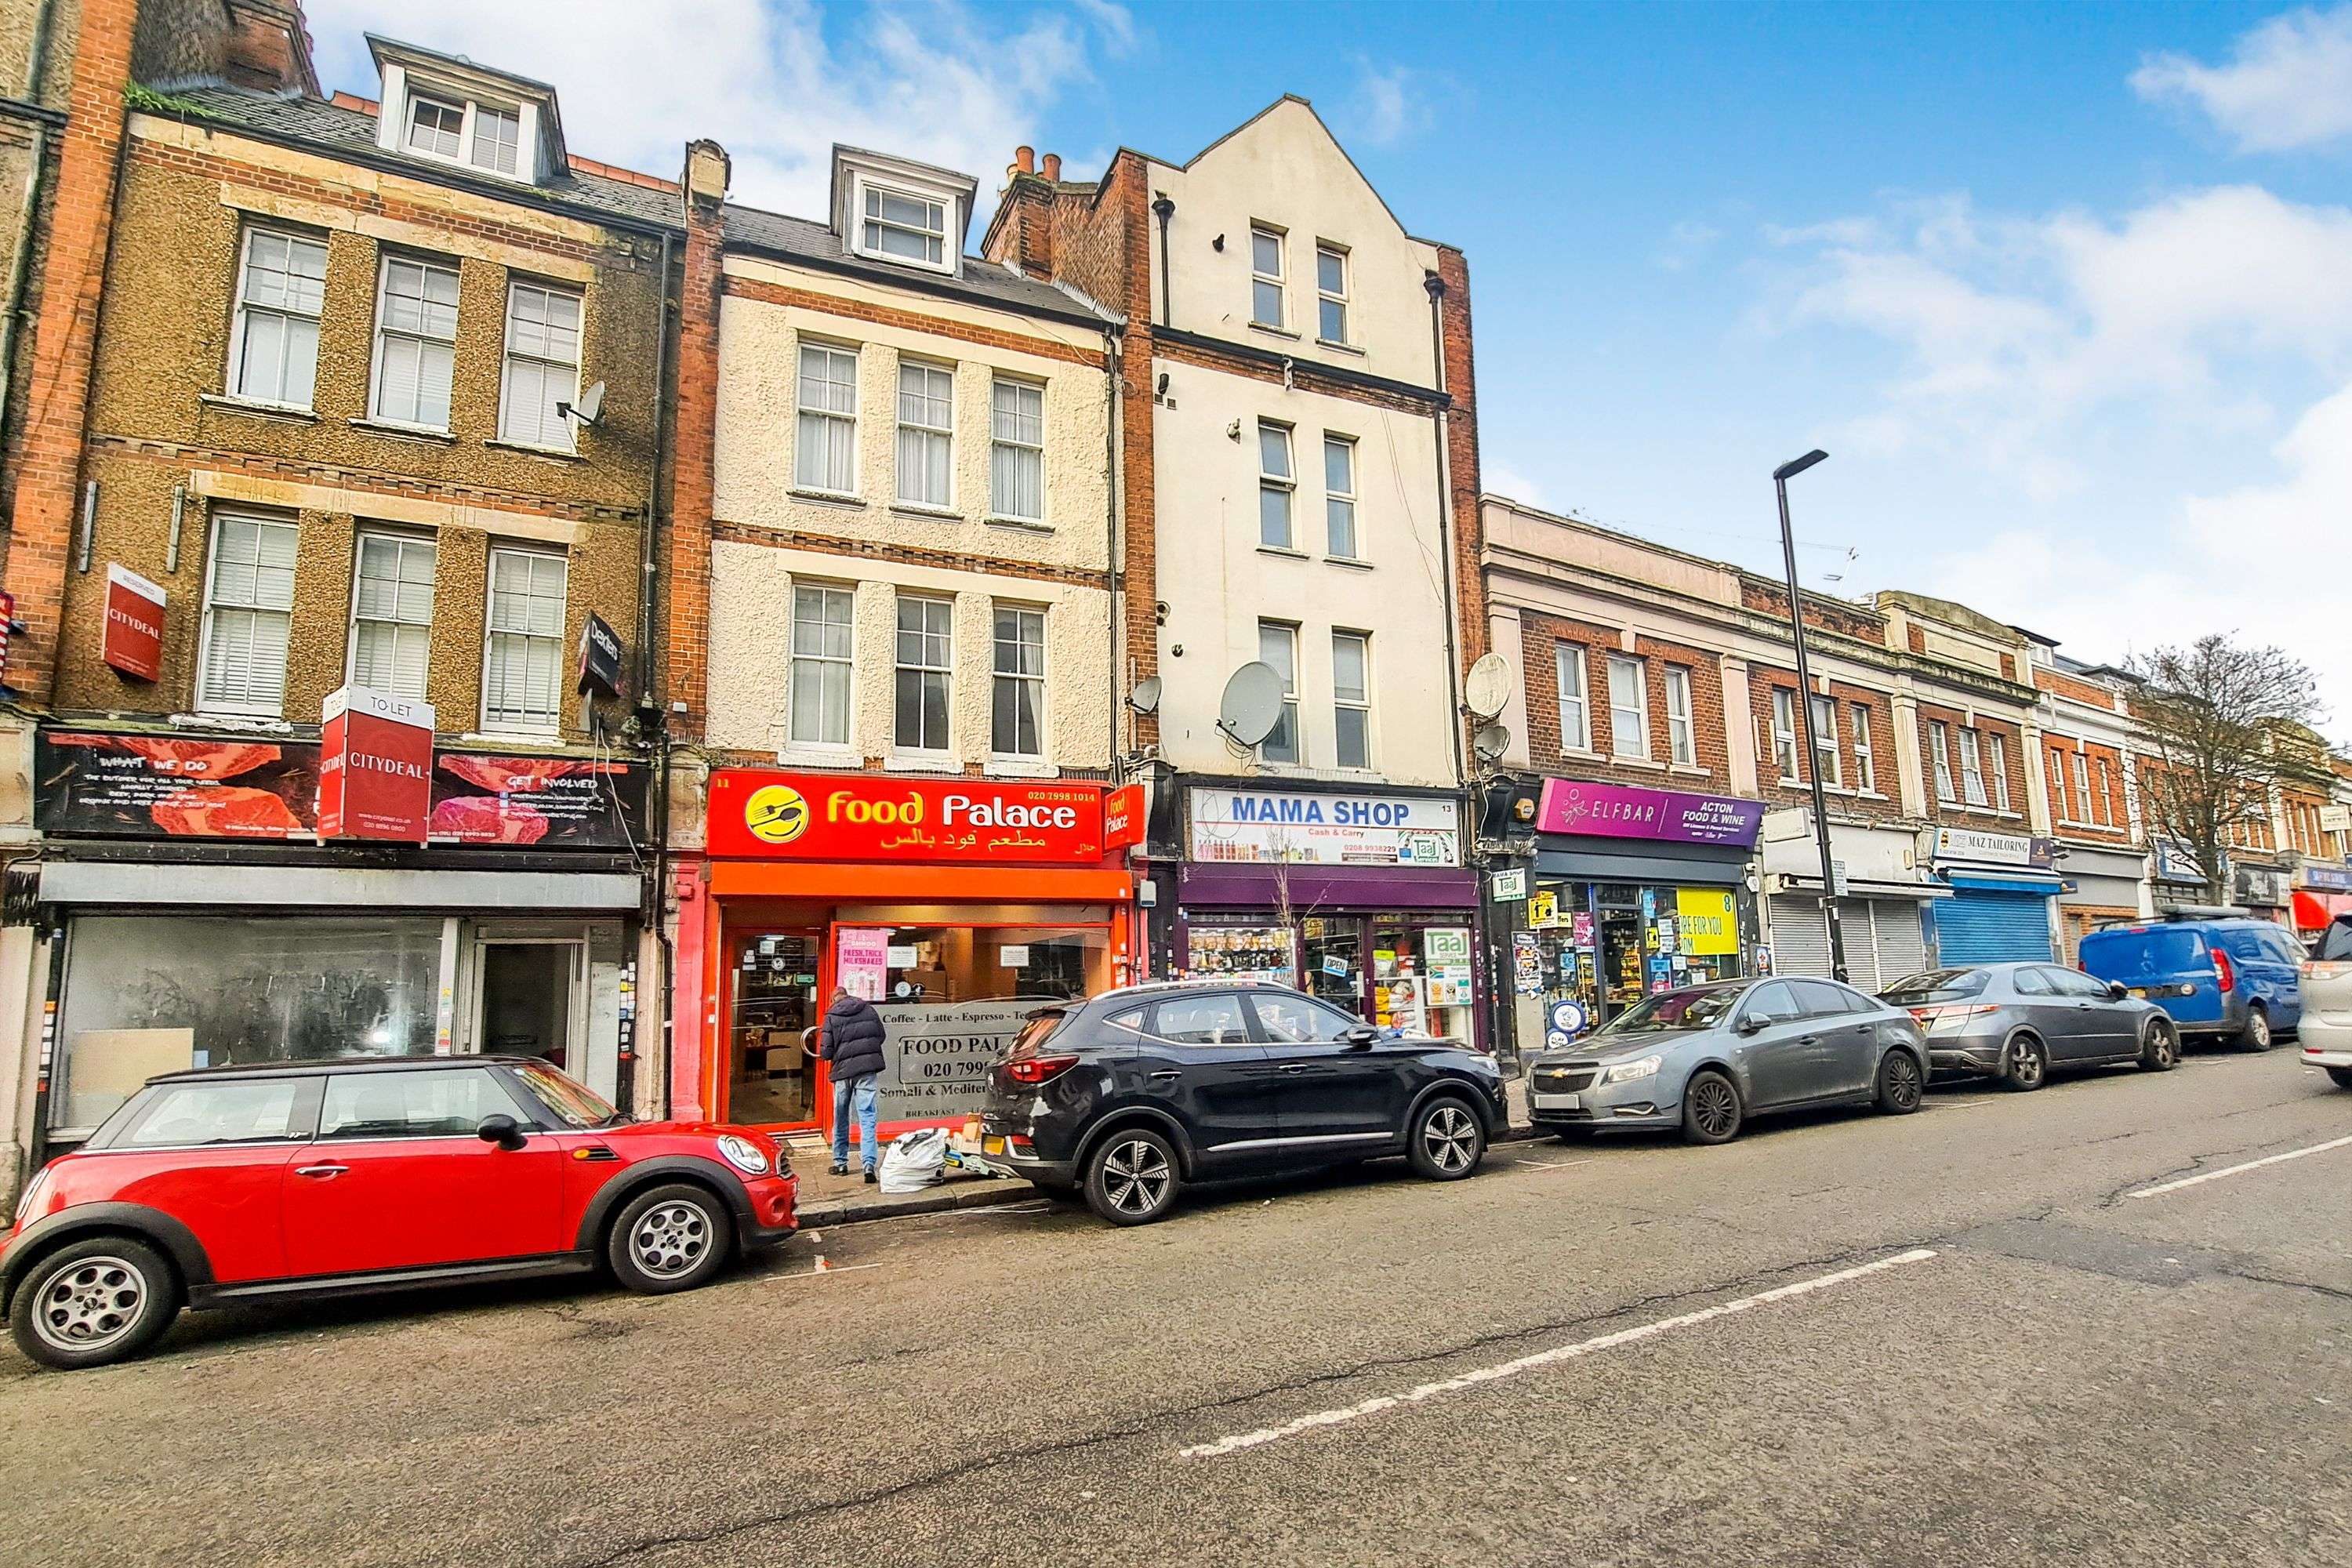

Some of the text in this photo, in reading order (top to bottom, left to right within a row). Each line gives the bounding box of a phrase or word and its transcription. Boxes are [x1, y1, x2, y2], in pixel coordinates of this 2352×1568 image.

[109, 608, 161, 640] CITYDEAL
[591, 619, 619, 662] Dexters
[371, 696, 412, 718] TO LET
[100, 757, 208, 771] WHAT WE DO
[350, 751, 425, 780] CITYDEAL
[507, 775, 598, 789] GET INVOLVED
[717, 779, 729, 788] 11
[1028, 791, 1095, 802] 020 7998 1014
[942, 794, 1076, 829] Palace
[1232, 796, 1410, 827] MAMA SHOP
[1442, 804, 1452, 813] 13
[1592, 800, 1654, 822] ELFBAR
[1700, 801, 1733, 814] ACTON
[1105, 814, 1129, 835] Palace
[1682, 810, 1746, 826] FOOD & WINE
[880, 827, 1046, 852] مطعم فود بالس
[1308, 828, 1330, 837] Cash
[1341, 829, 1365, 839] Carry
[1414, 839, 1437, 856] Taaj
[1968, 835, 2028, 853] MAZ TAILORING
[1498, 876, 1517, 892] Taaj
[1693, 916, 1708, 935] FOR
[1708, 916, 1722, 936] YOU
[1426, 931, 1468, 956] Taaj
[843, 956, 884, 966] MILKSHAKES
[1327, 959, 1345, 971] OPEN
[883, 1013, 916, 1024] Coffee
[926, 1012, 953, 1022] Latte
[962, 1011, 1004, 1023] Espresso
[903, 1038, 962, 1055] FOOD
[924, 1061, 989, 1077] 020 799
[880, 1086, 921, 1098] Somali
[926, 1085, 937, 1096] &
[905, 1109, 956, 1118] BREAKFAST
